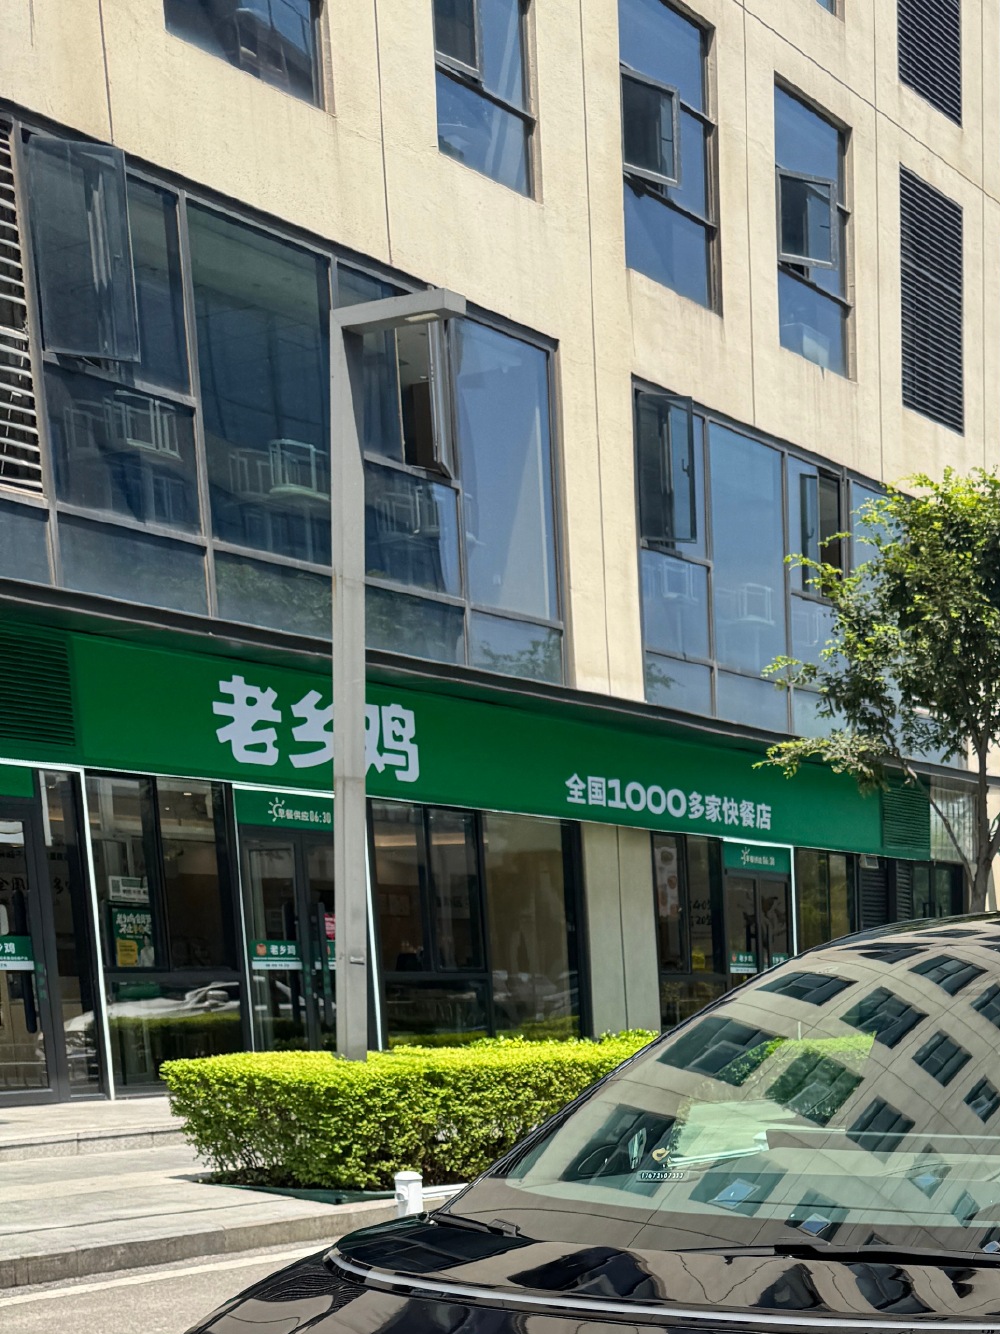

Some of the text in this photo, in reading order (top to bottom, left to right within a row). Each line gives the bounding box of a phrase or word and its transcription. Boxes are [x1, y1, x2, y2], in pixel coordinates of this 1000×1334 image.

[212, 674, 420, 783] 老乡鸡
[565, 773, 772, 830] 全国1000多家快餐店
[269, 944, 297, 956] 老乡鸡
